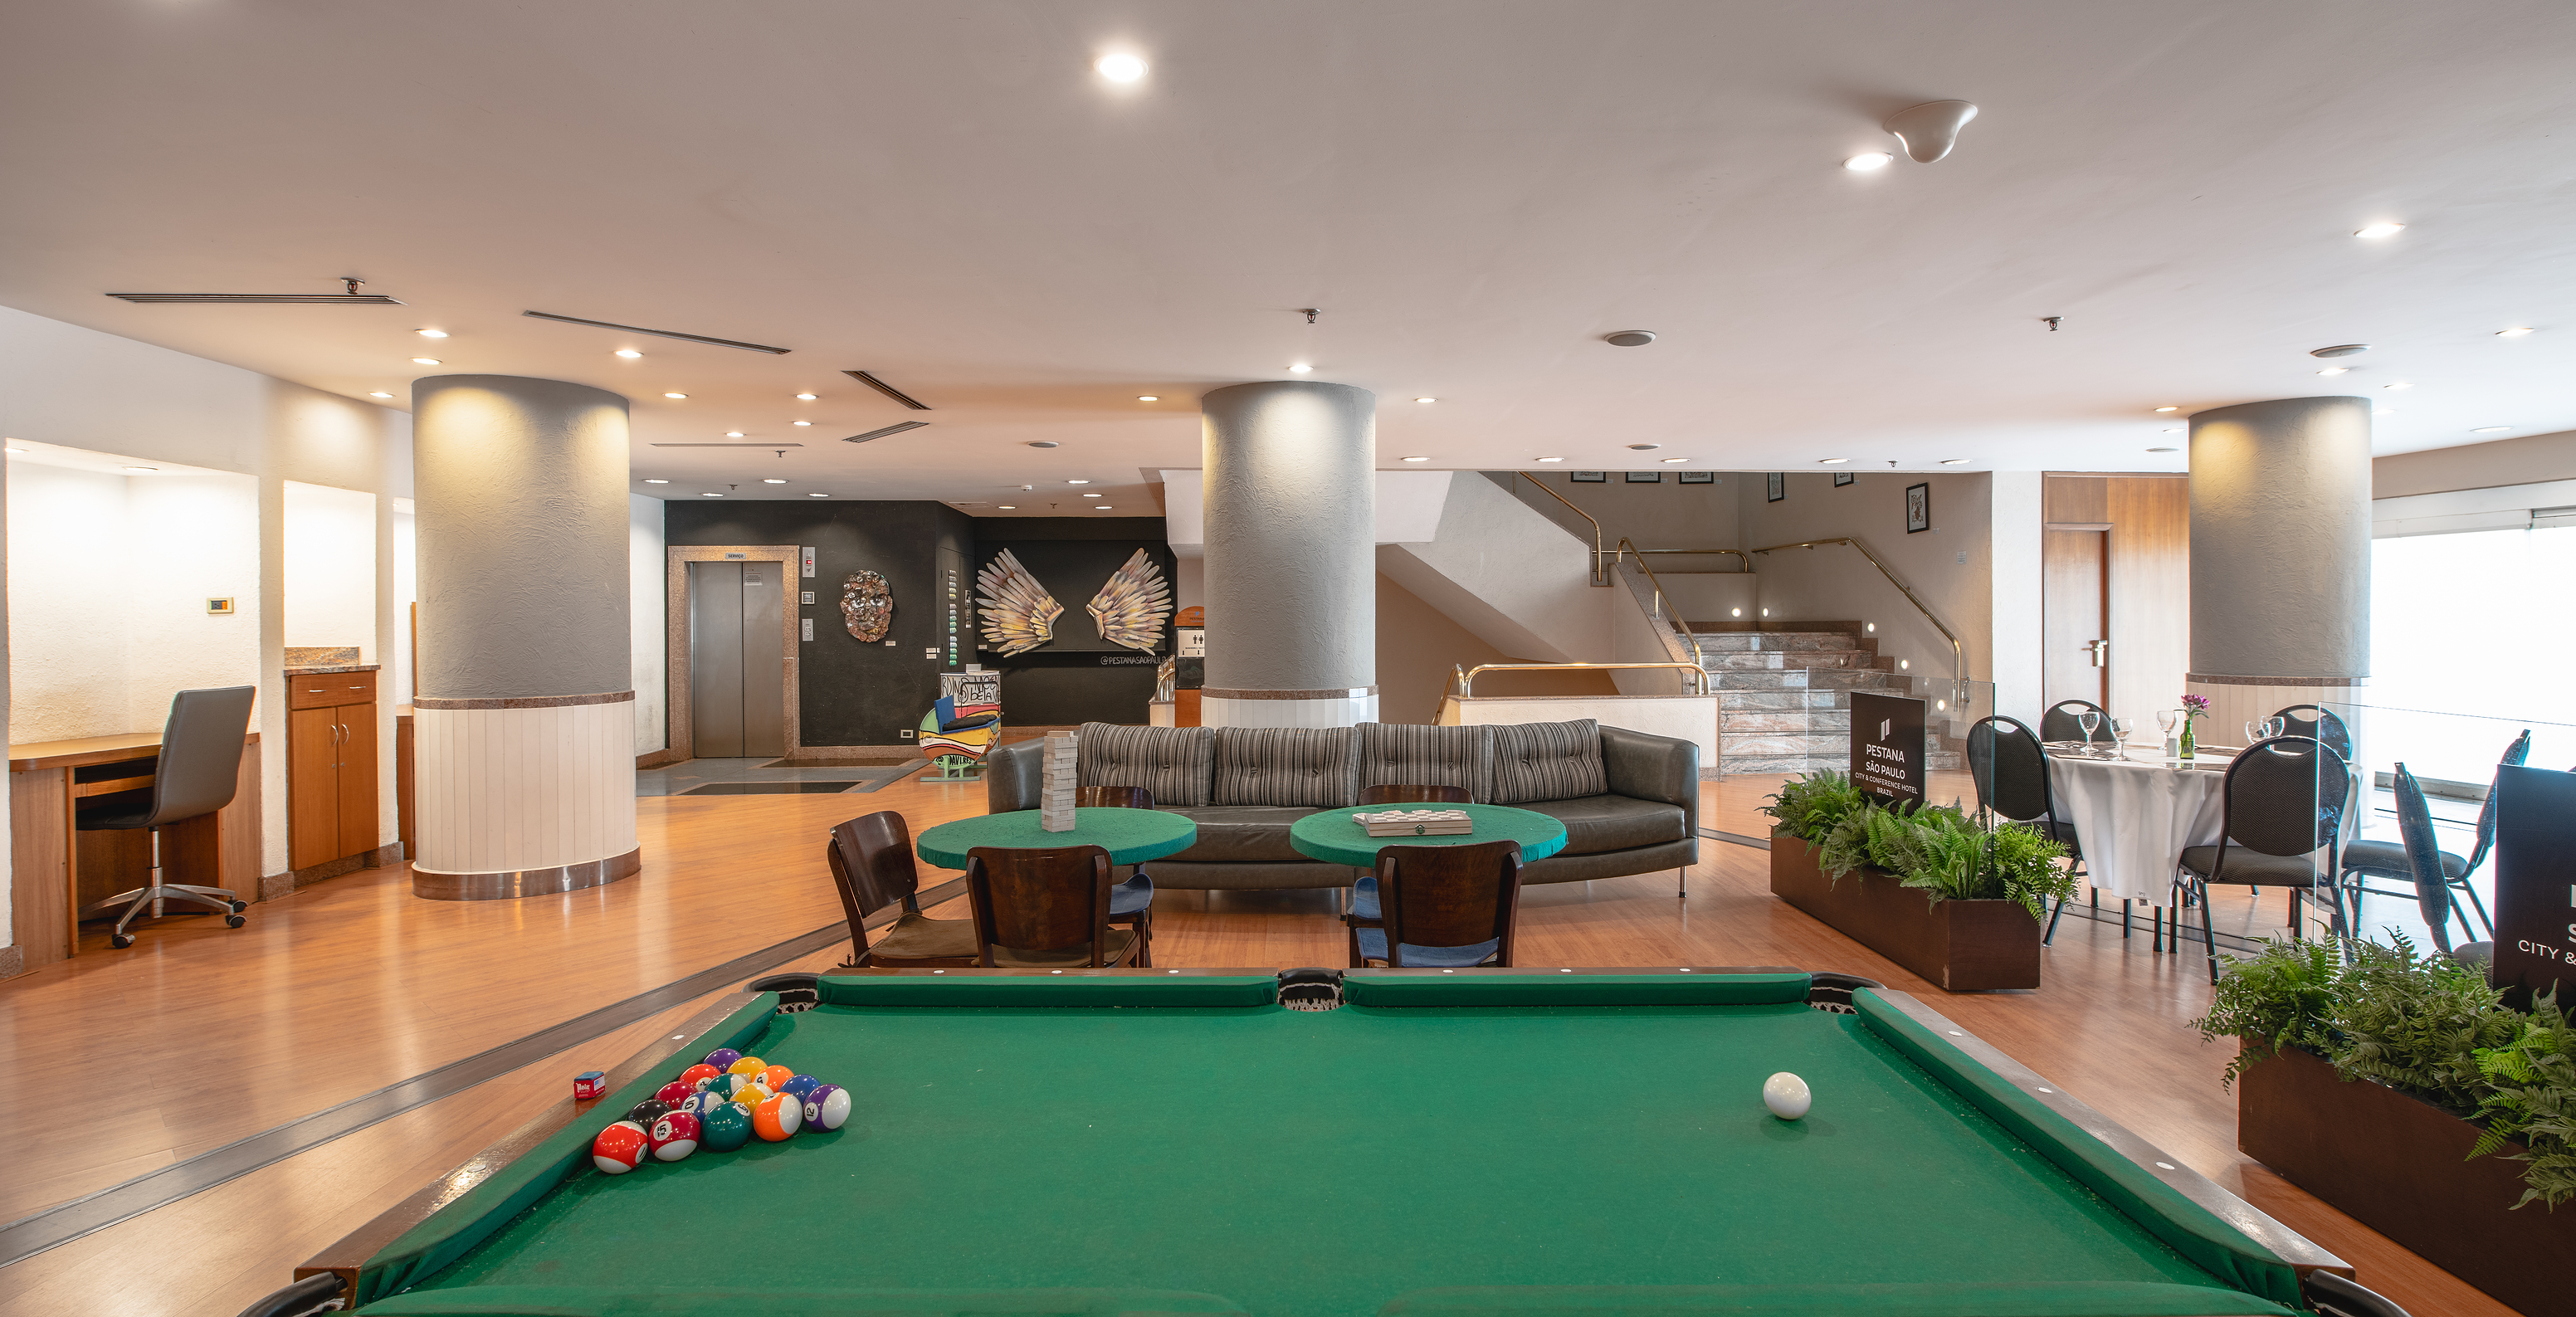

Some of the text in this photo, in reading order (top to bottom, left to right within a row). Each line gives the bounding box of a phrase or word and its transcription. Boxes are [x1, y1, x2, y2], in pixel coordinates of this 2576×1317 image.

[1866, 744, 1905, 763] PESTANA
[1866, 760, 1905, 779] SÃO PAULO
[1870, 776, 1900, 789] CONFERENCE
[1901, 783, 1919, 794] HOTEL
[1877, 787, 1893, 797] BRAZIL
[2518, 939, 2576, 966] CITY &
[806, 1107, 815, 1117] 12
[656, 1124, 667, 1138] 15
